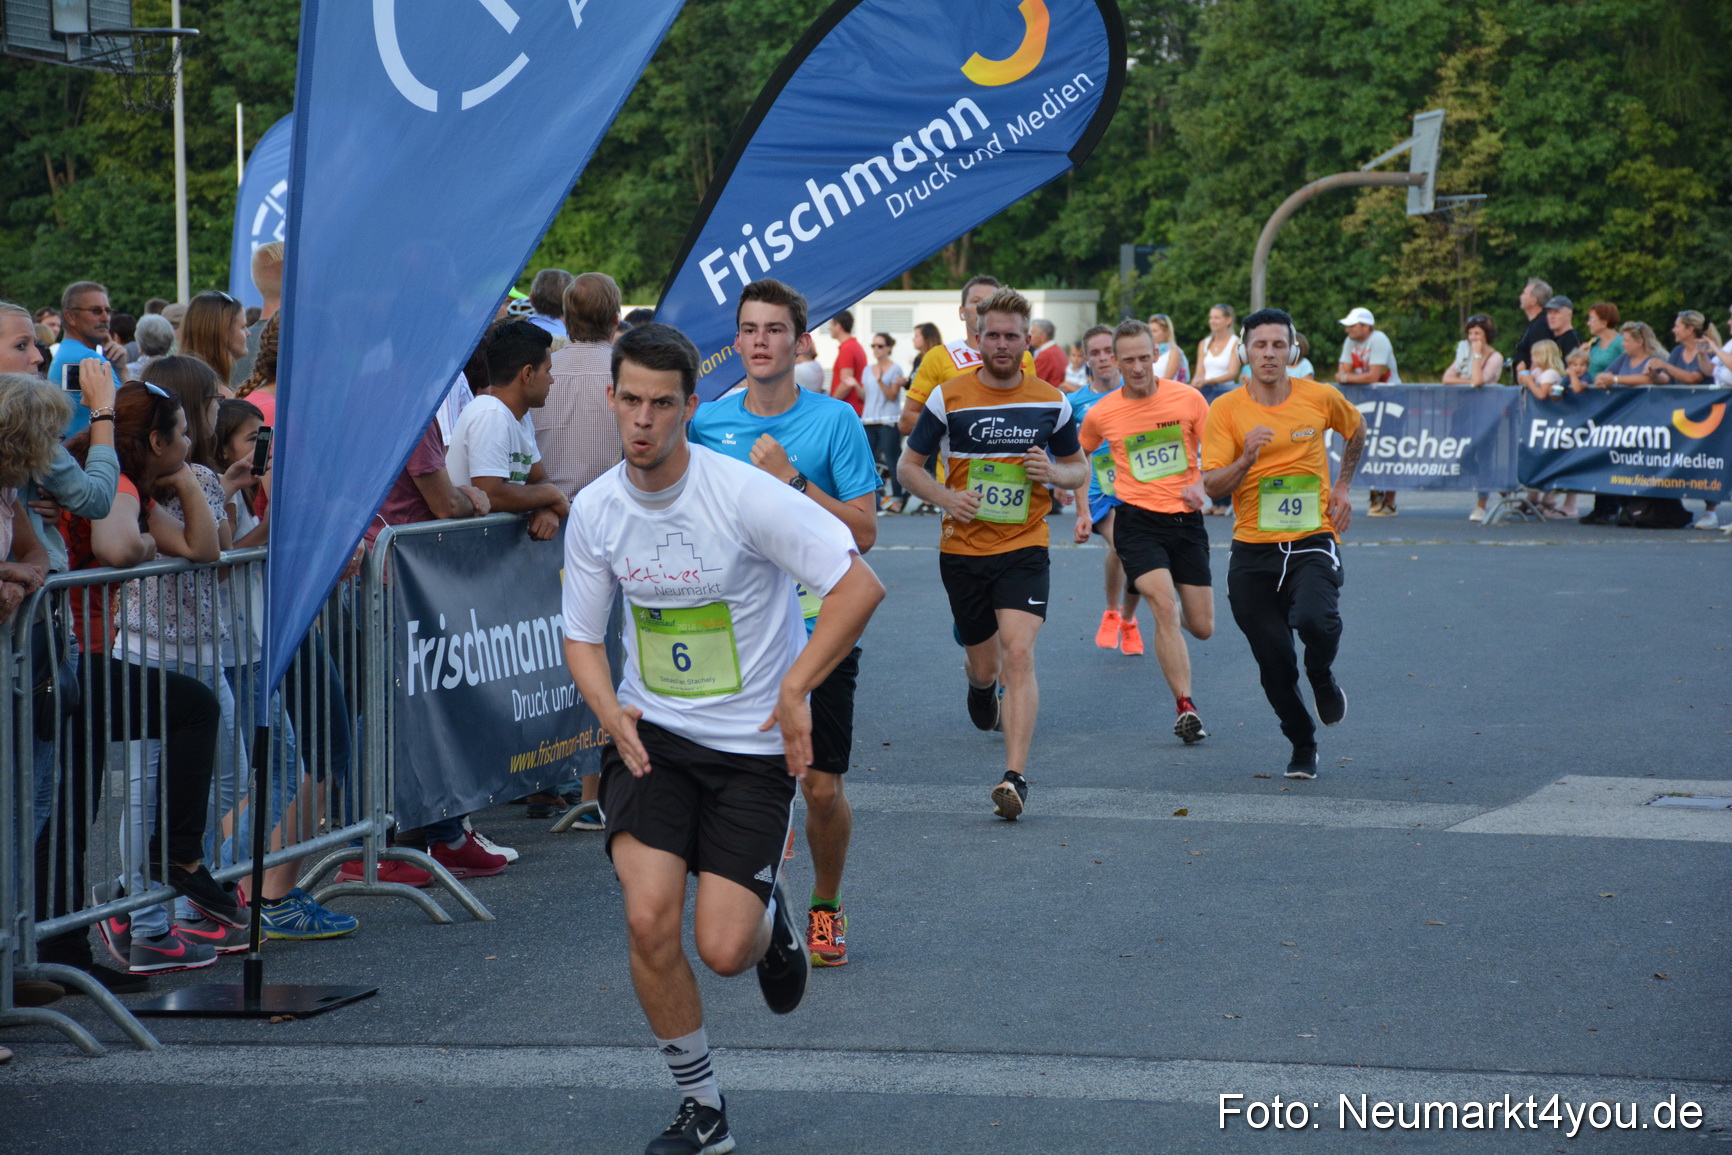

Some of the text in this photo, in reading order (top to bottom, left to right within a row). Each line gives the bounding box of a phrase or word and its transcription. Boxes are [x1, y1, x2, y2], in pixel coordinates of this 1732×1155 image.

[885, 71, 1096, 219] Druck und Medien
[699, 97, 990, 306] Frischmann
[981, 426, 1039, 439] Fischer
[1528, 418, 1672, 450] Frischmann
[1134, 444, 1179, 469] 1567
[1609, 450, 1724, 470] Druck und Medien
[1361, 462, 1461, 476] AUTOMOBILE
[1610, 474, 1722, 491] www.frischmann-net.de
[974, 483, 1025, 507] 1638
[1278, 498, 1302, 516] 49
[654, 583, 722, 597] Neumarkt
[407, 608, 566, 697] Frischmann
[671, 642, 692, 672] 6
[660, 675, 716, 686] Sebastian Stachely
[511, 682, 549, 722] Druck
[551, 680, 576, 713] und
